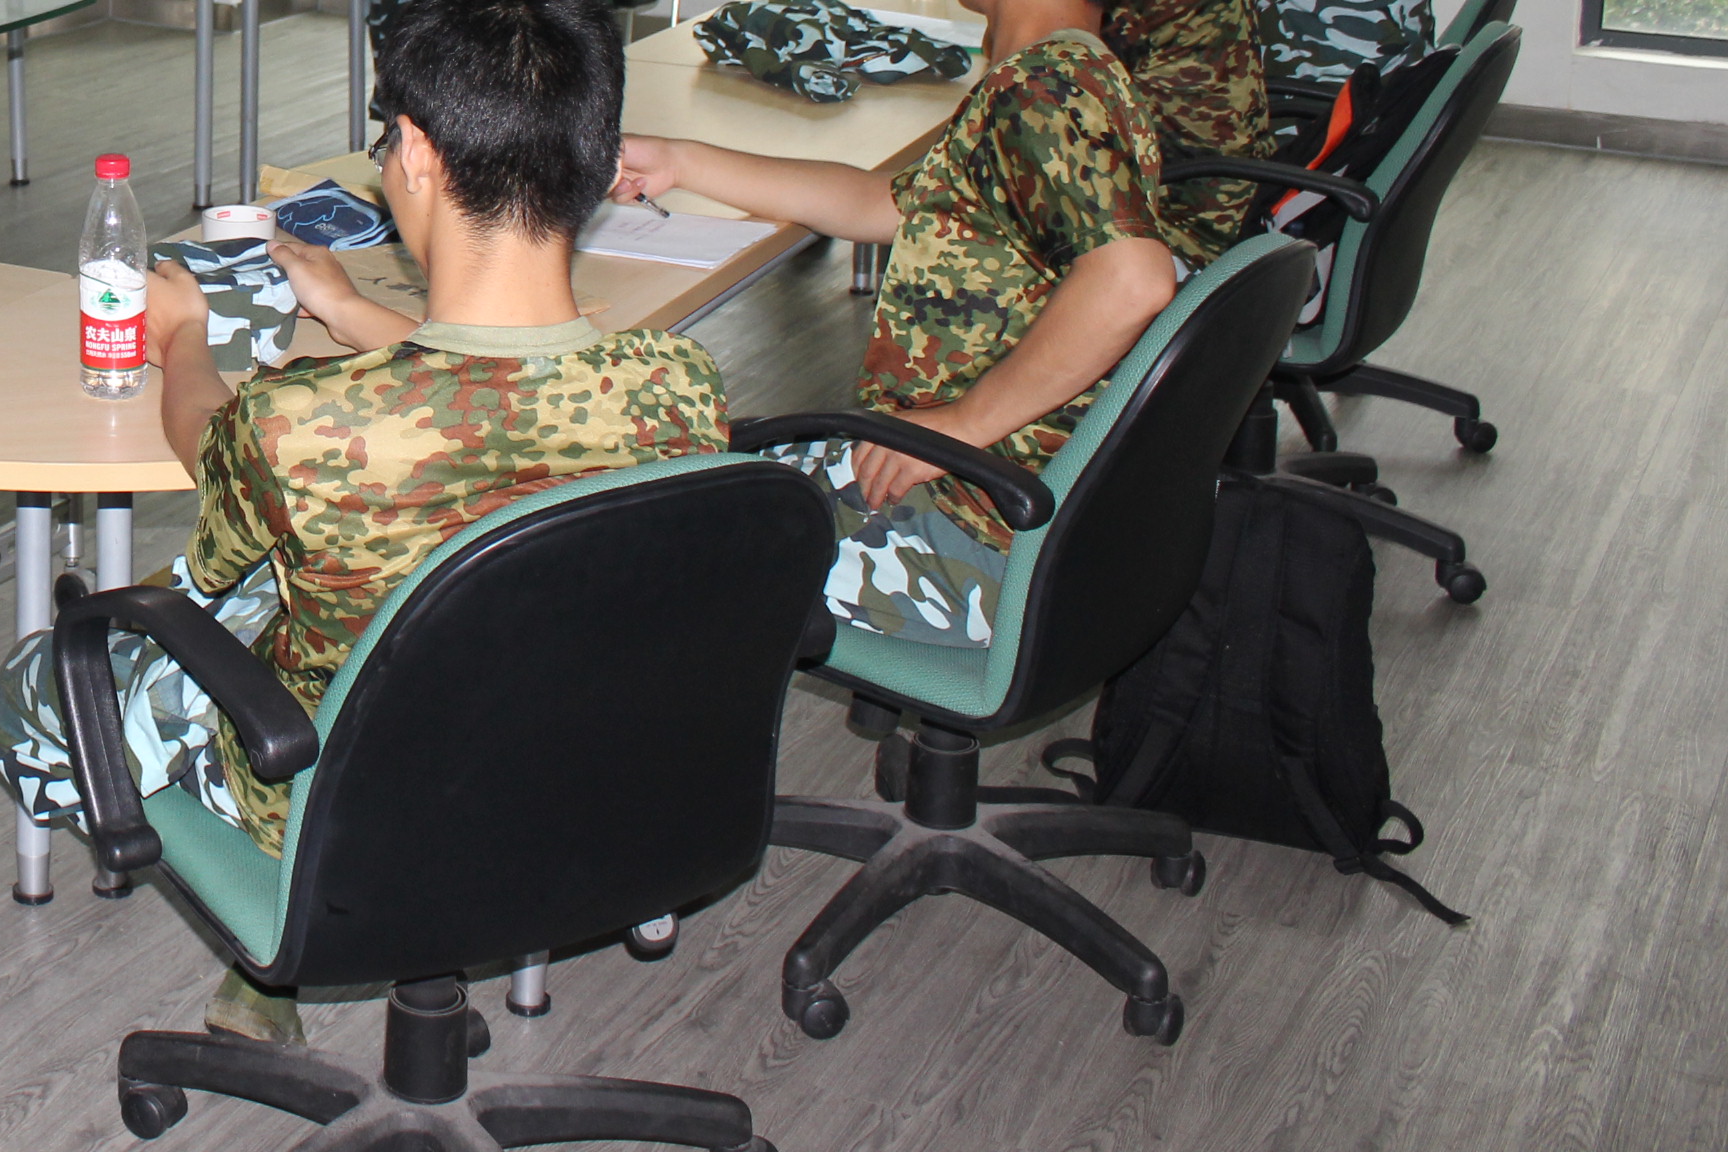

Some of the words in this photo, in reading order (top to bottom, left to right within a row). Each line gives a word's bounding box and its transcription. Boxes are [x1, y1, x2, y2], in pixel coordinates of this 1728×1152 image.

[85, 326, 137, 342] 农夫山泉
[85, 340, 111, 352] NONGFU
[111, 341, 137, 352] SPRING
